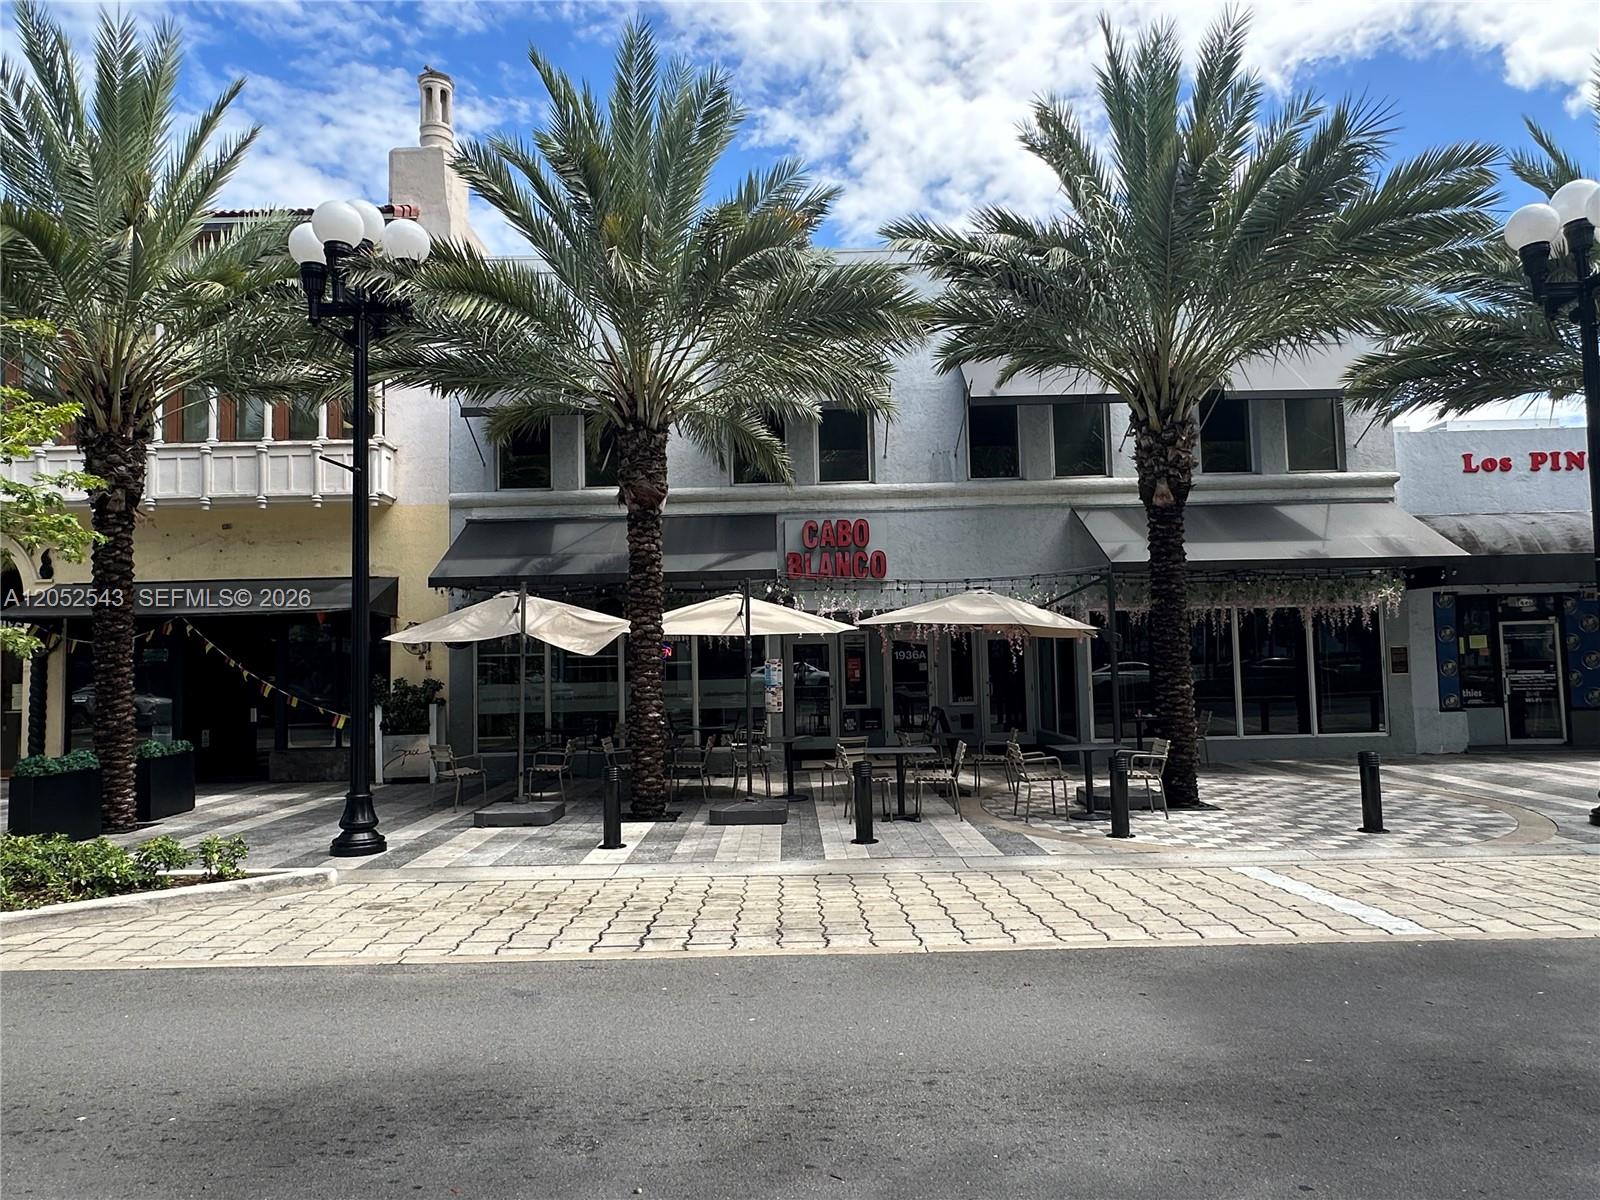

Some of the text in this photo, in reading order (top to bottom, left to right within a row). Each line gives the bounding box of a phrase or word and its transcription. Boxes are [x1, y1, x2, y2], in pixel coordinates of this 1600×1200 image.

[1461, 451, 1587, 473] Los PIN
[802, 519, 870, 550] CABO
[786, 550, 887, 581] BLANCO
[893, 649, 927, 660] 1936A
